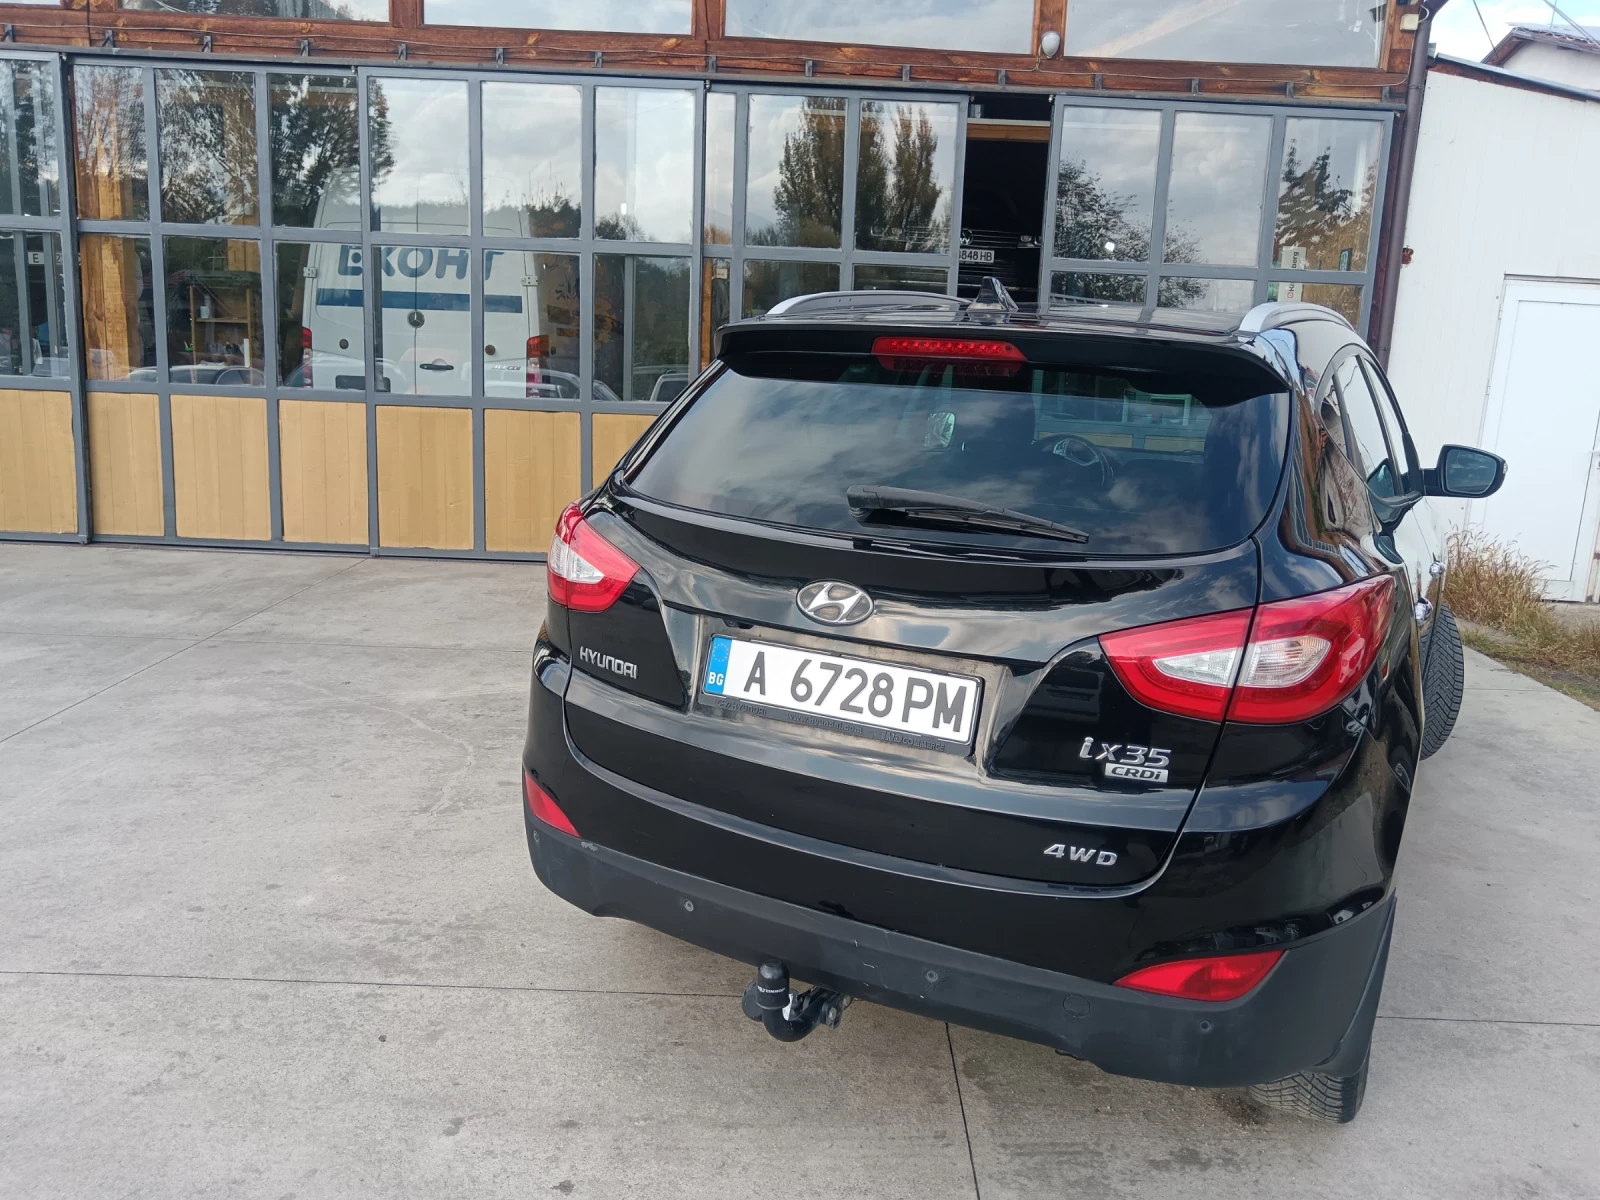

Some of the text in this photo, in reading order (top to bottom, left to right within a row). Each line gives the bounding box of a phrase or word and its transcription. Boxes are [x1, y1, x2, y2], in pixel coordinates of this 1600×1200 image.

[958, 249, 979, 261] 848
[579, 645, 638, 680] HYUNDAI
[707, 671, 725, 687] BG
[743, 650, 967, 733] A 6728 PM
[787, 713, 863, 733] www.hyundai.com
[1110, 765, 1162, 781] CRDi
[1043, 843, 1118, 866] 4WD
